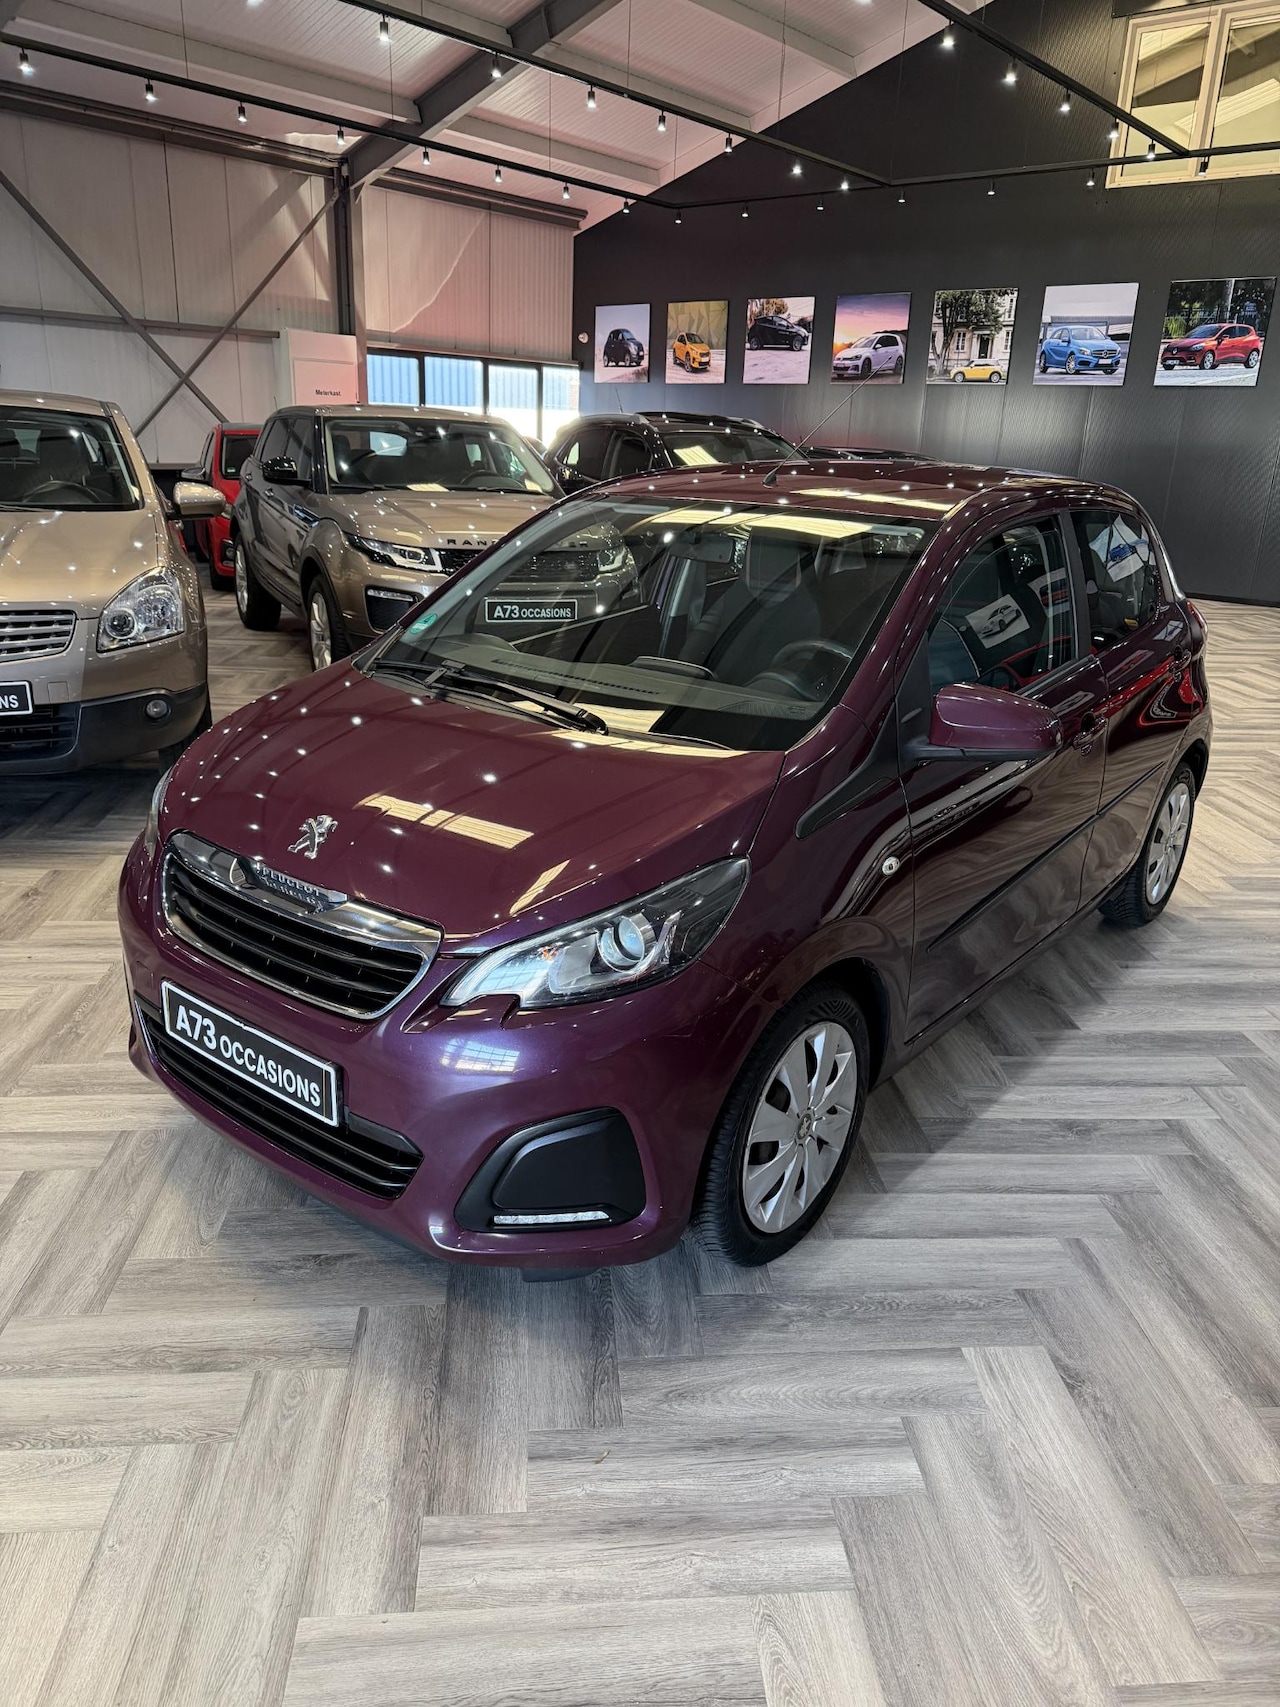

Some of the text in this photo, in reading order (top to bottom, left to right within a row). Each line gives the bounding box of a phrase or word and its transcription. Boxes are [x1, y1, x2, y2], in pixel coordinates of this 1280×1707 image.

[493, 605, 572, 618] A73 OCCASIONS
[262, 866, 320, 896] PEUGEOT
[175, 1004, 321, 1107] A73 OCCASIONS
